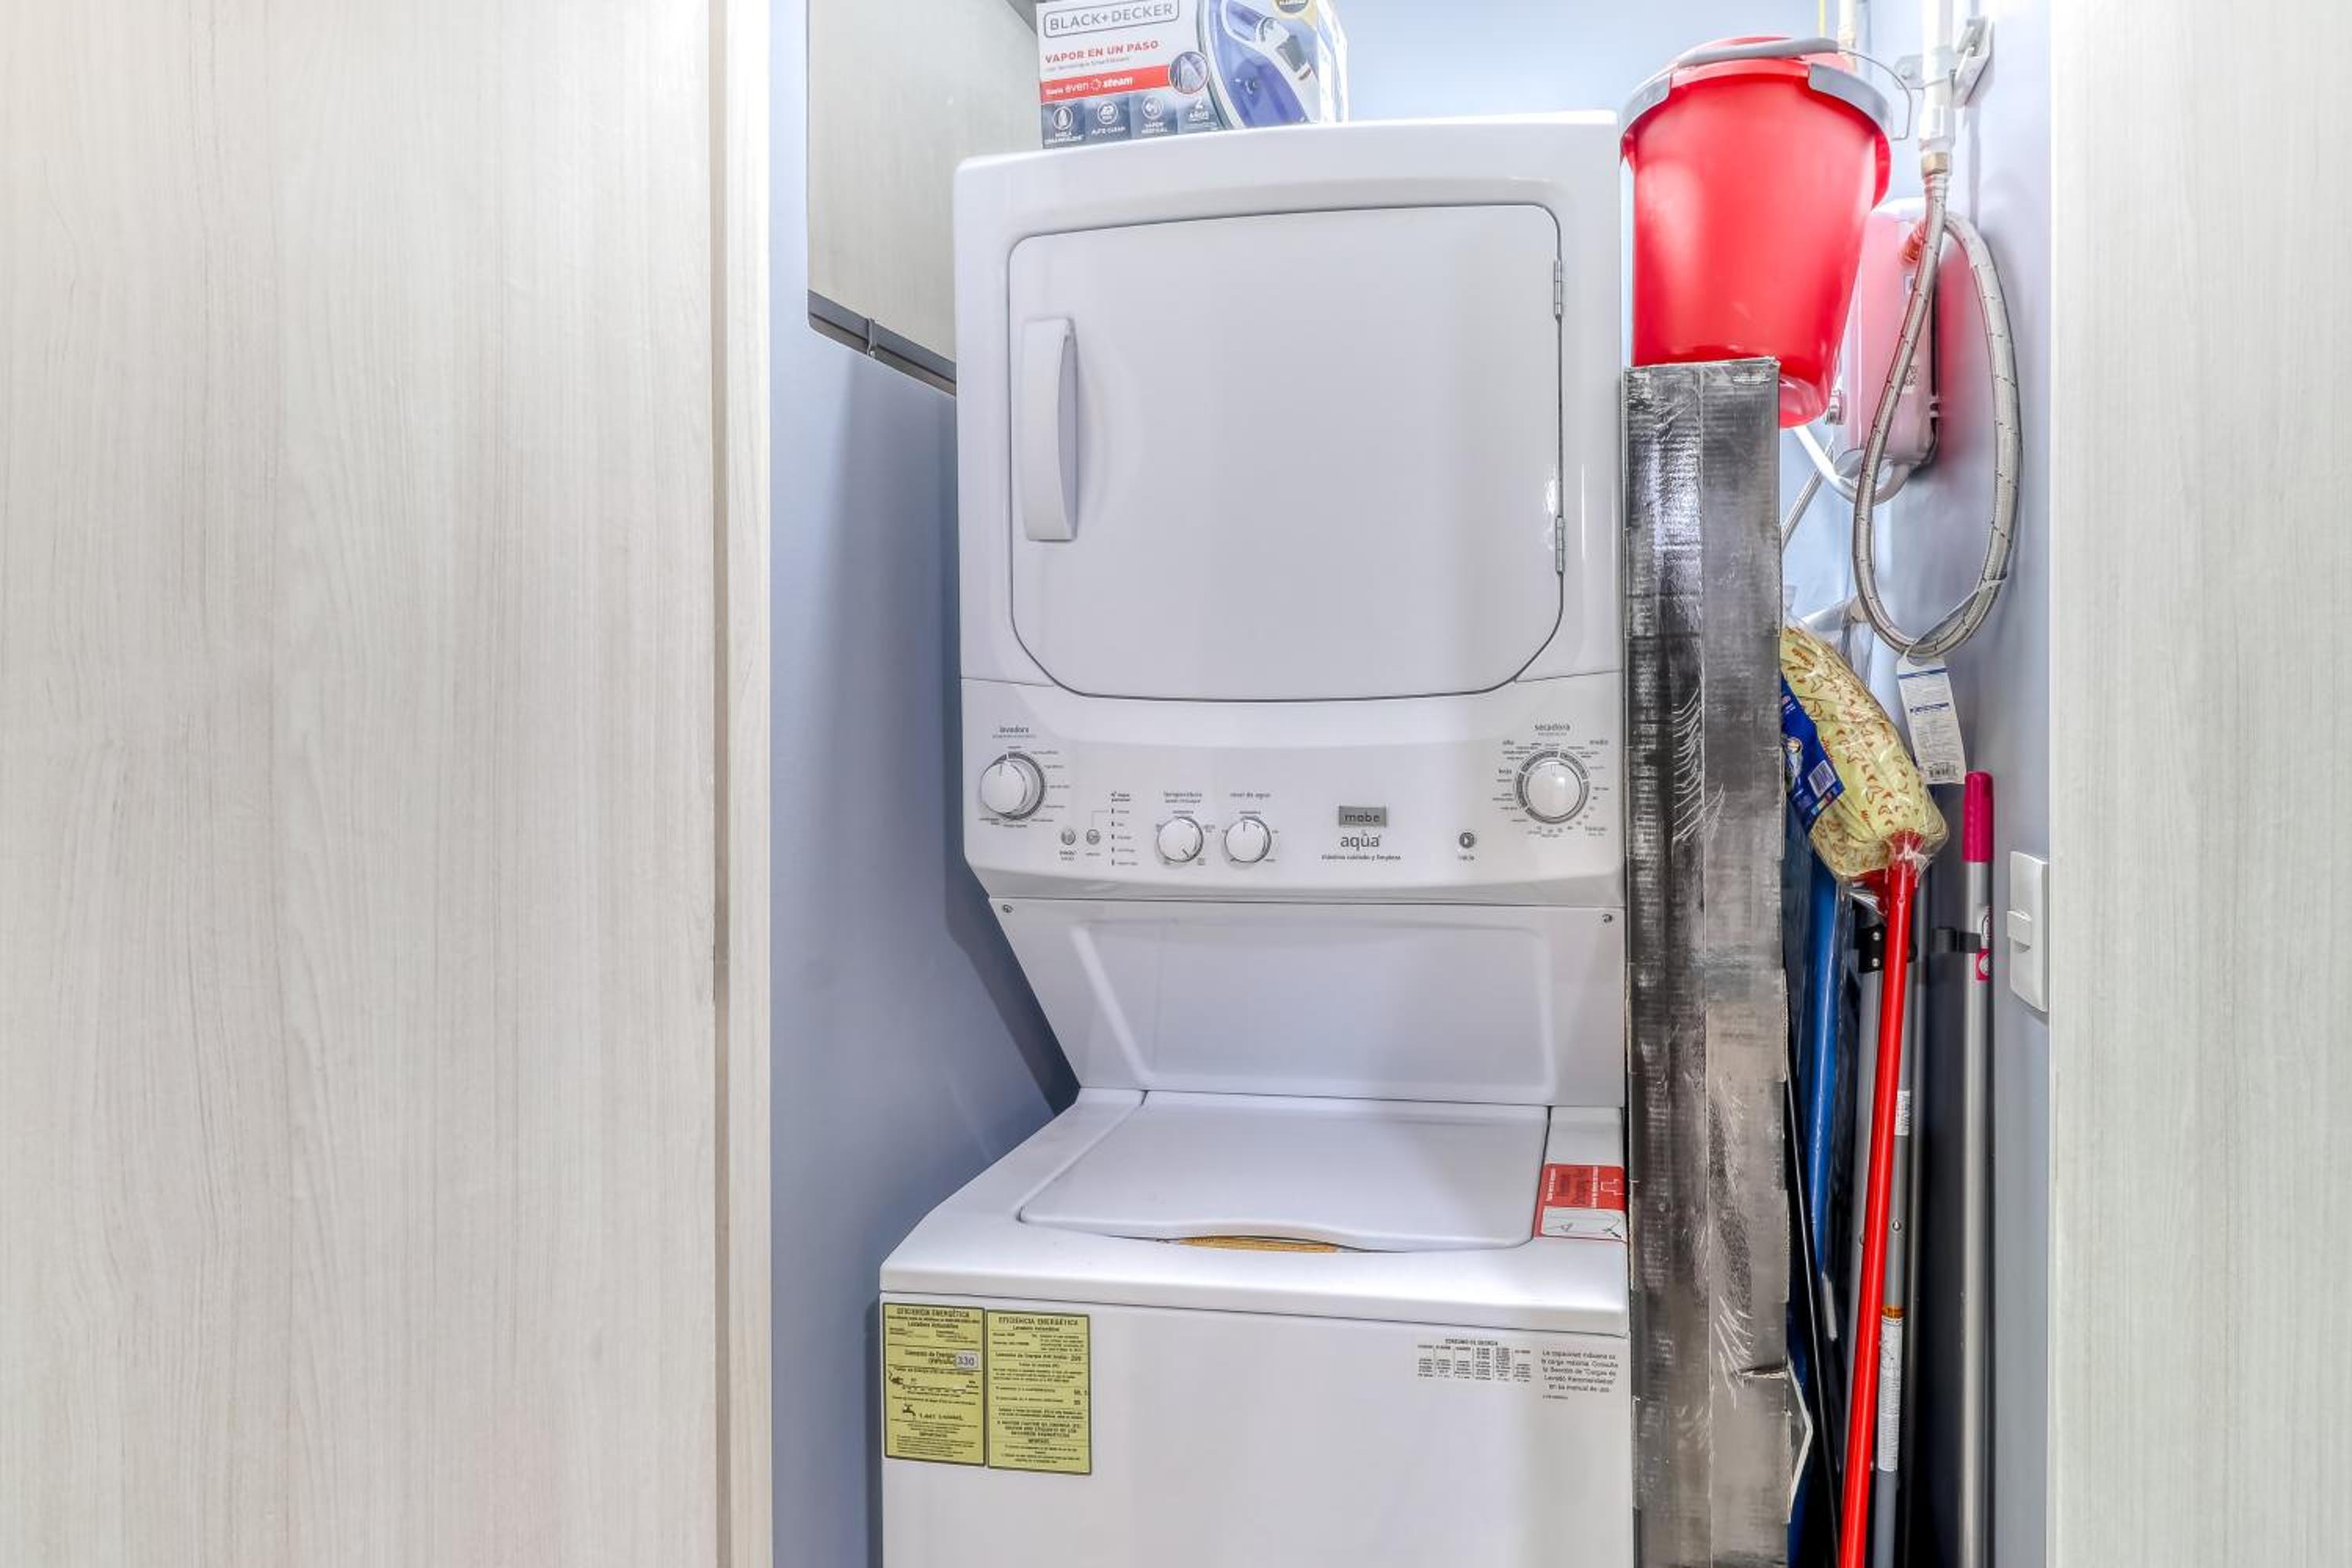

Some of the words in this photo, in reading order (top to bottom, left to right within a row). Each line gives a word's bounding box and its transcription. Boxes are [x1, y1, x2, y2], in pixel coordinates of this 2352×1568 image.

[1049, 3, 1173, 31] BLACK+DECKER
[1045, 51, 1085, 64] VAPOR
[1087, 48, 1104, 58] EN
[1106, 44, 1124, 55] UN
[1127, 40, 1159, 53] PASO
[1103, 77, 1134, 88] steam
[957, 1356, 975, 1366] 330
